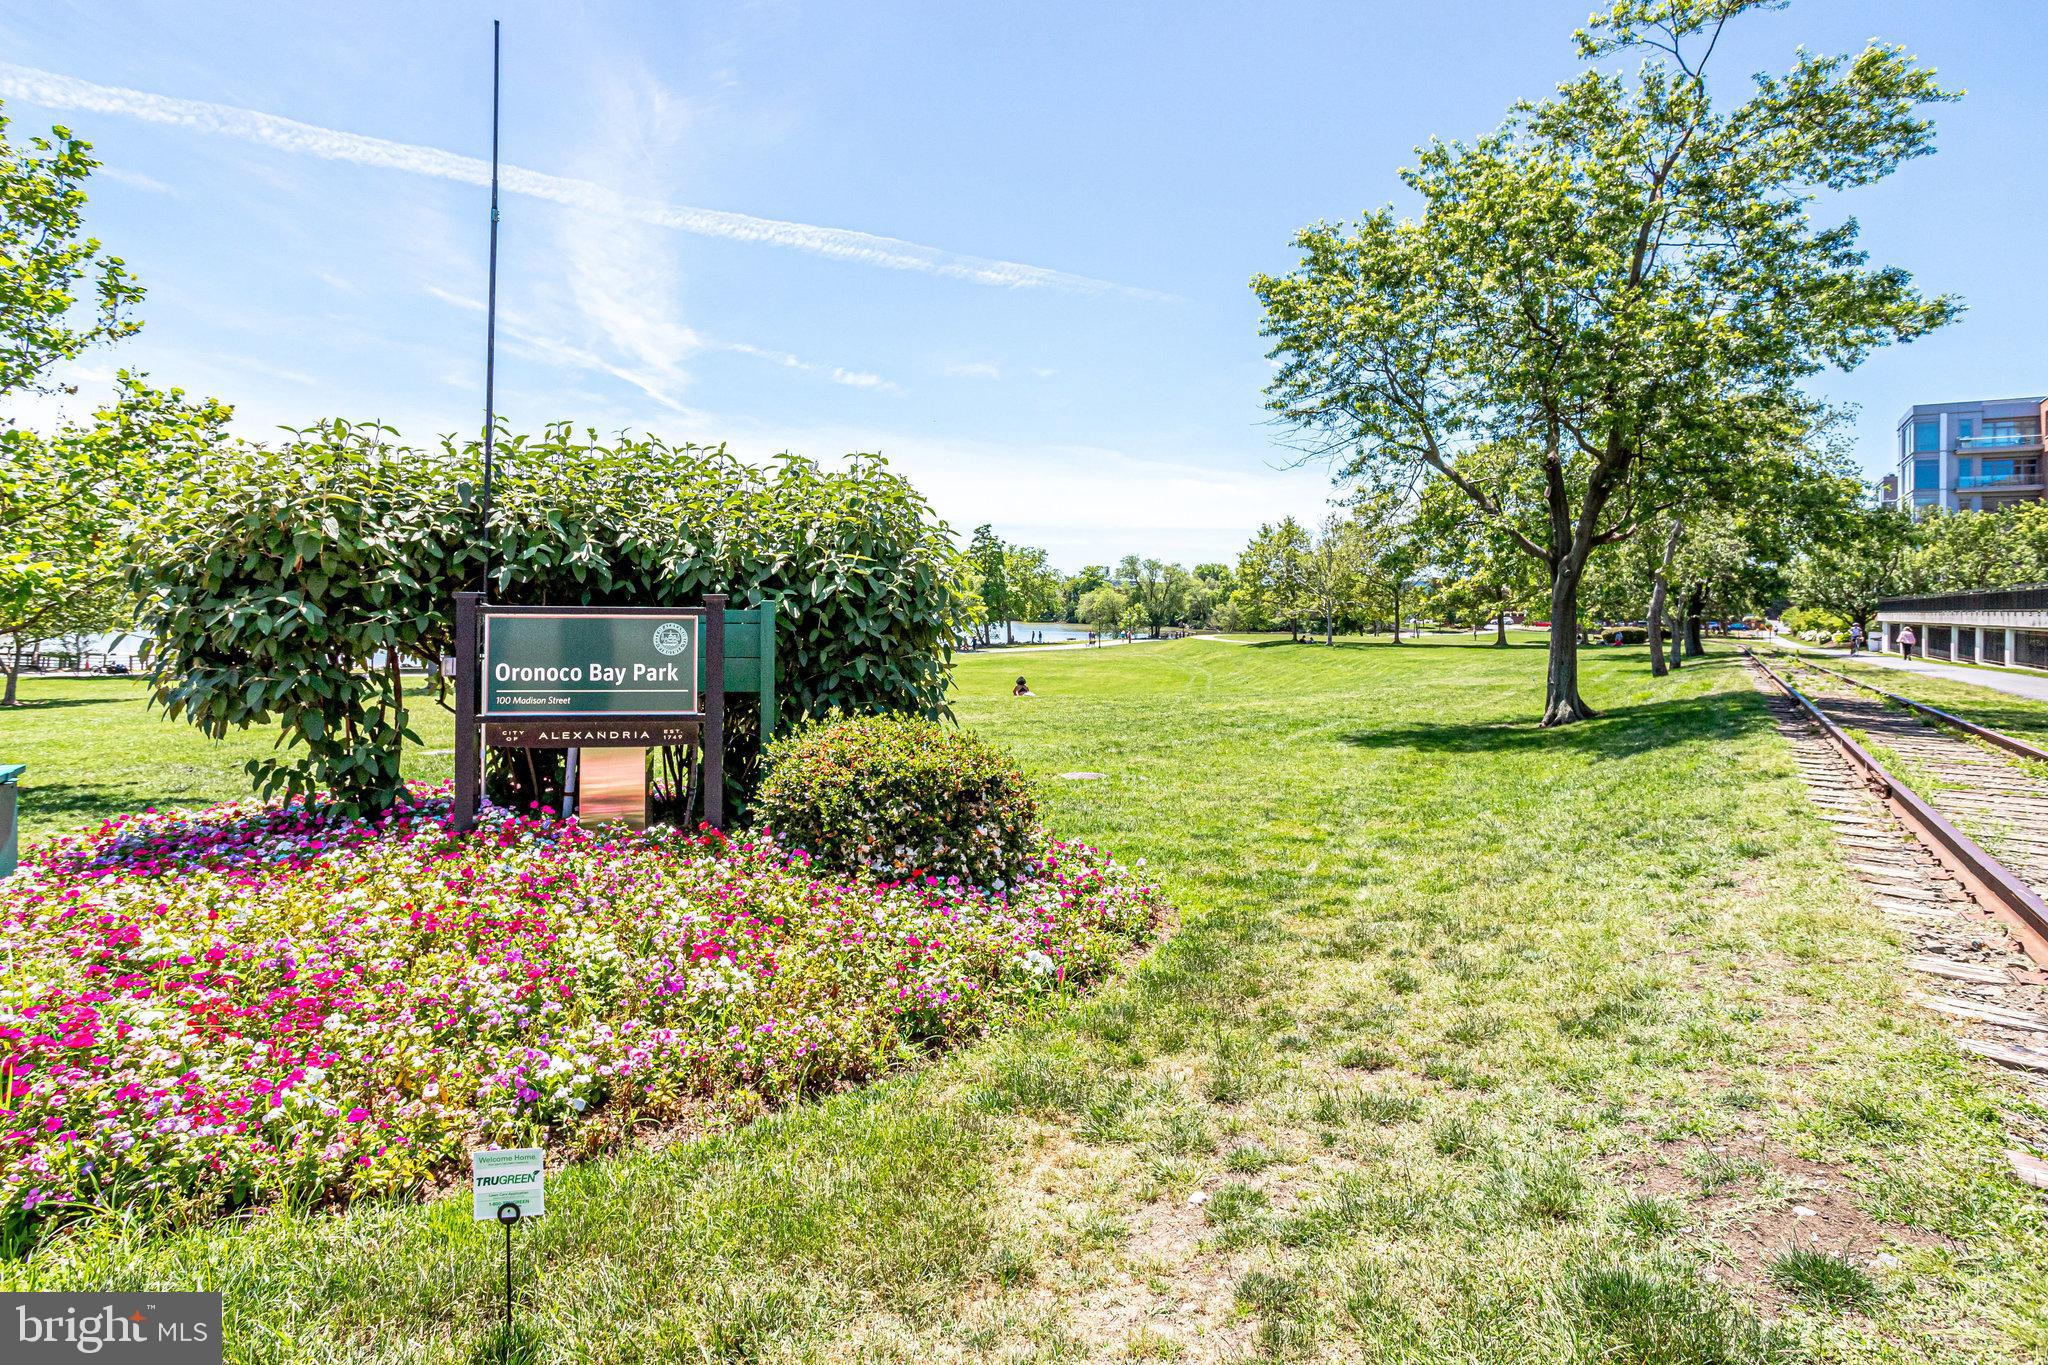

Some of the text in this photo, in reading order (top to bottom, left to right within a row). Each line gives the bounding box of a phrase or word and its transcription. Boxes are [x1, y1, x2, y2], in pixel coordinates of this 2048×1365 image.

[495, 662, 679, 686] Oronoco Bay Park
[496, 696, 571, 705] 100 Madison Street
[538, 731, 650, 740] ALEXANDRIA
[479, 1156, 513, 1164] Welcome
[476, 1173, 536, 1187] TRUGREEN
